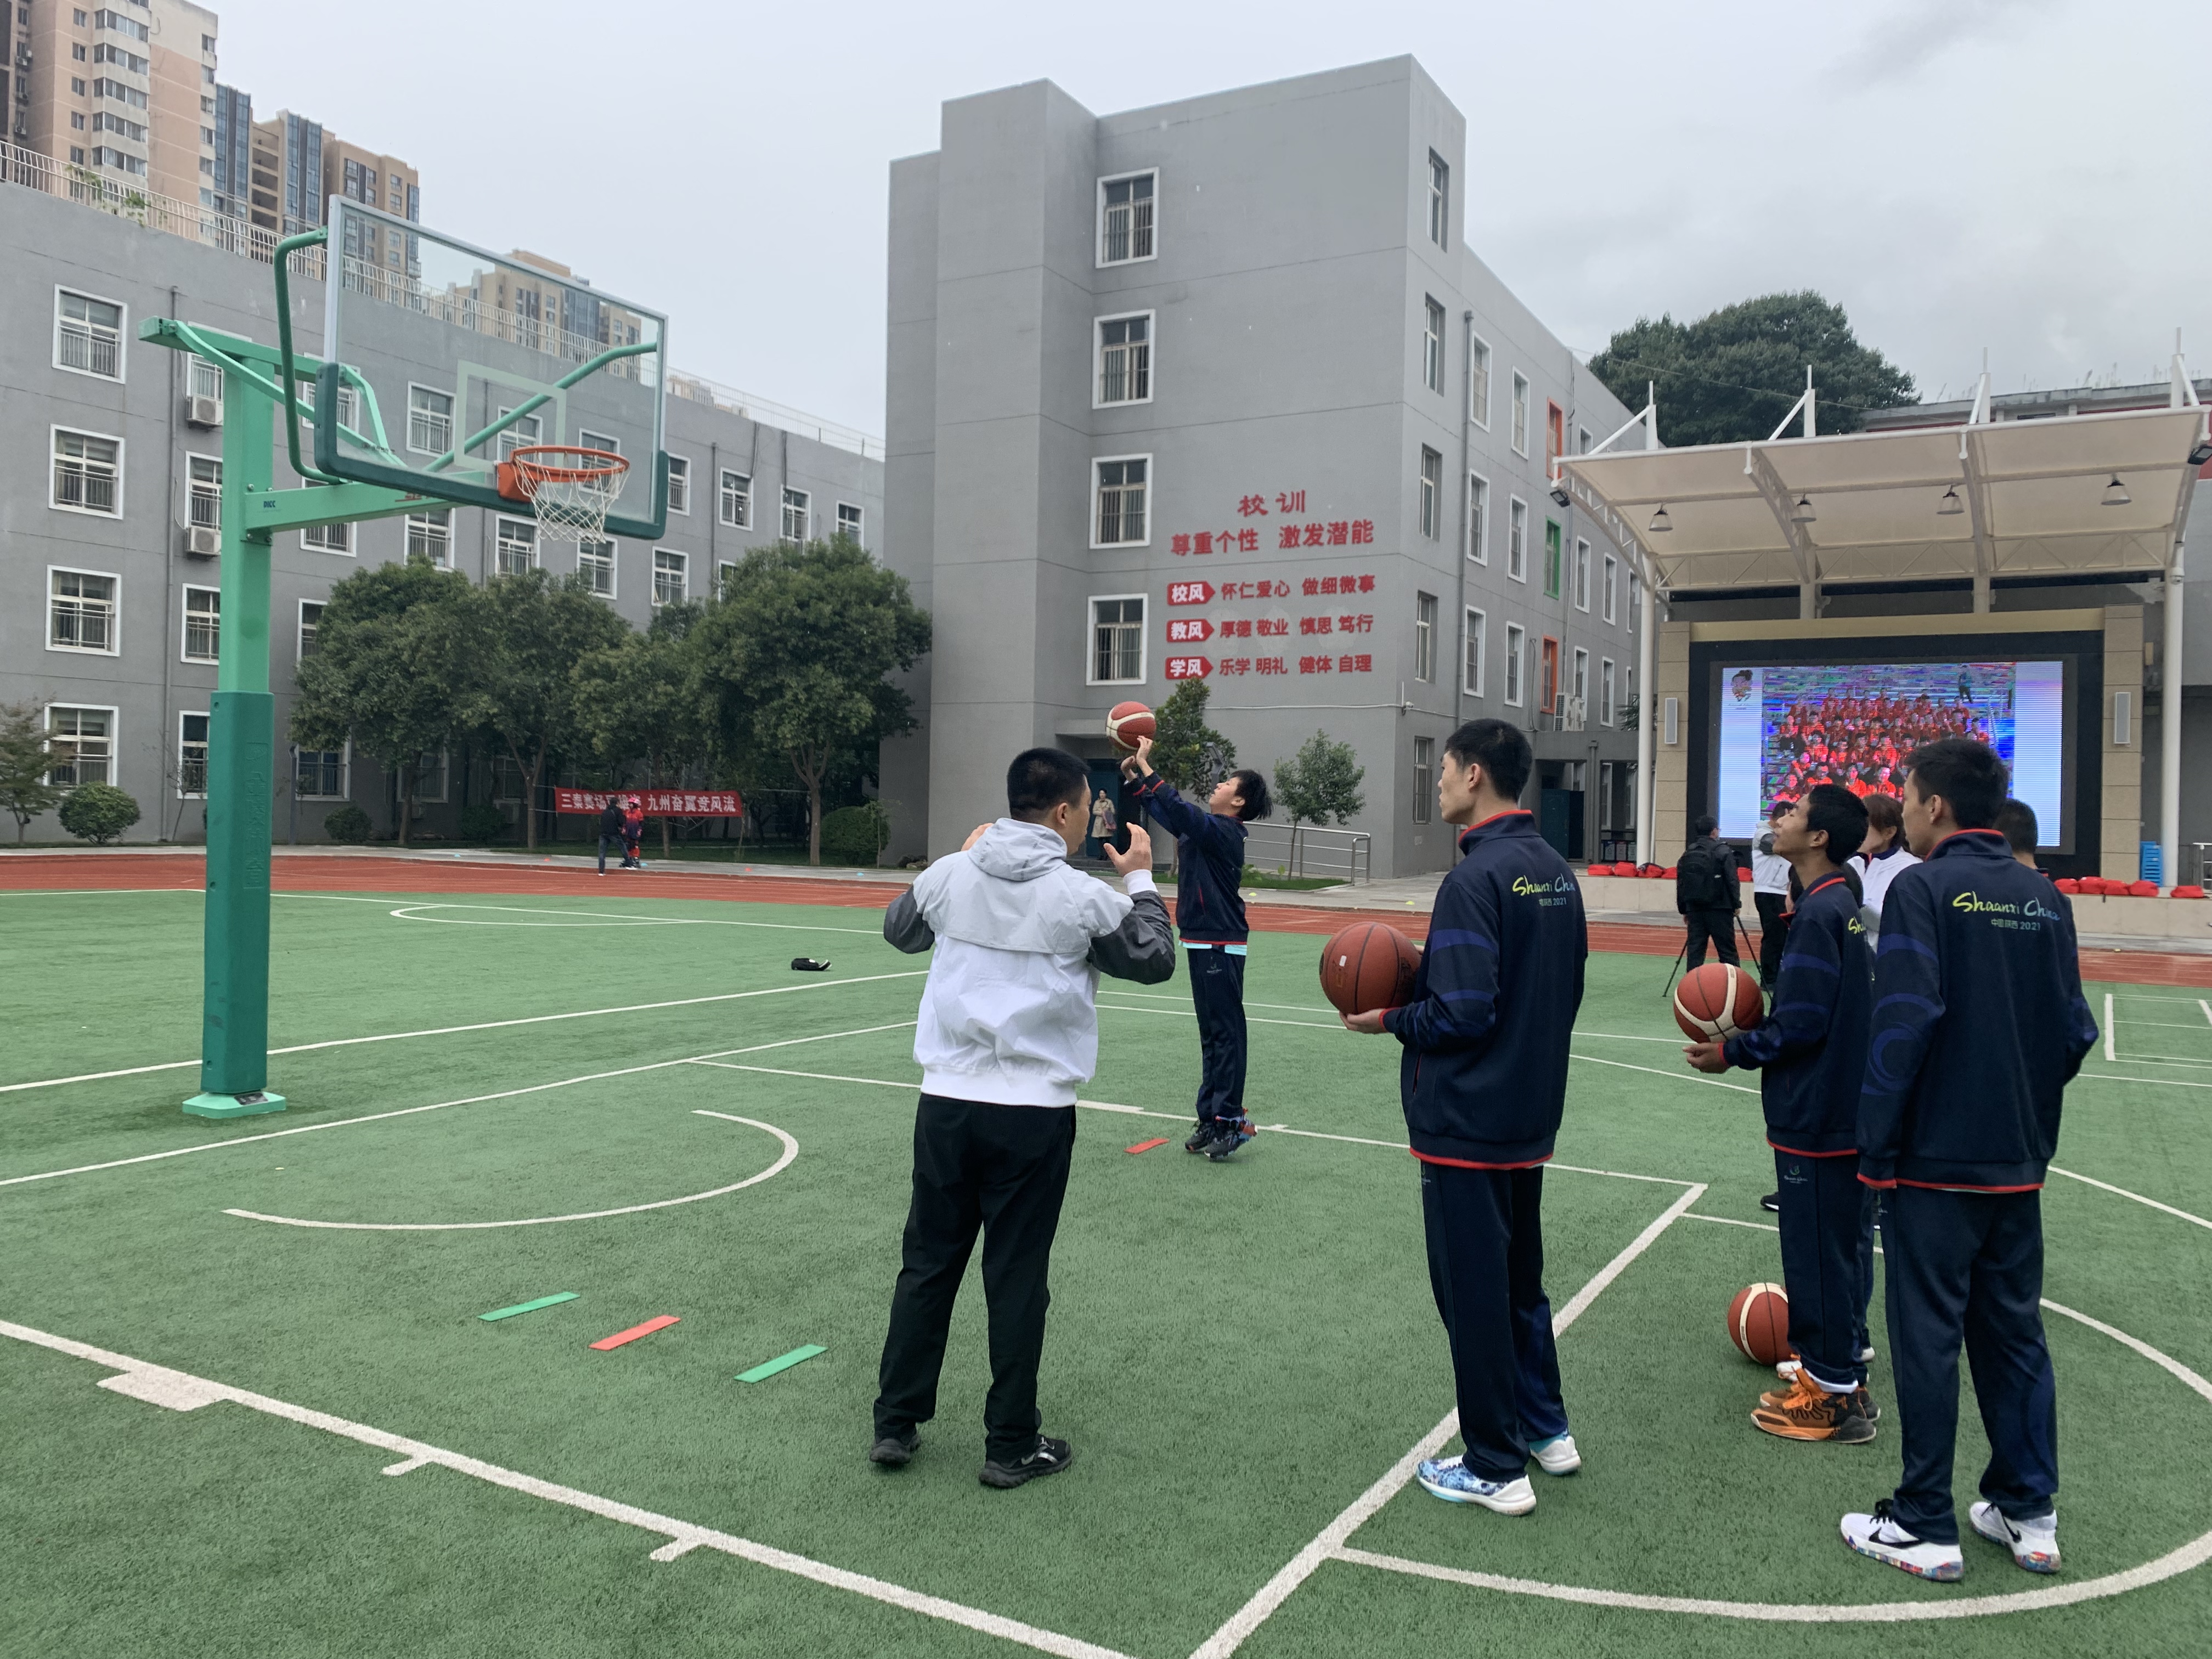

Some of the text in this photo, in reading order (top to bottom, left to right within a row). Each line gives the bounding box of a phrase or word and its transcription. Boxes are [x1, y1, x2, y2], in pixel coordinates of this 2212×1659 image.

[1238, 490, 1305, 517] 校训
[1171, 520, 1374, 556] 尊重个性 激发潜能
[1171, 574, 1375, 602] 校风 怀仁爱心 做细微事
[1171, 622, 1203, 640] 教风
[1170, 659, 1203, 676] 学风
[1953, 891, 2020, 915] Shaanxi
